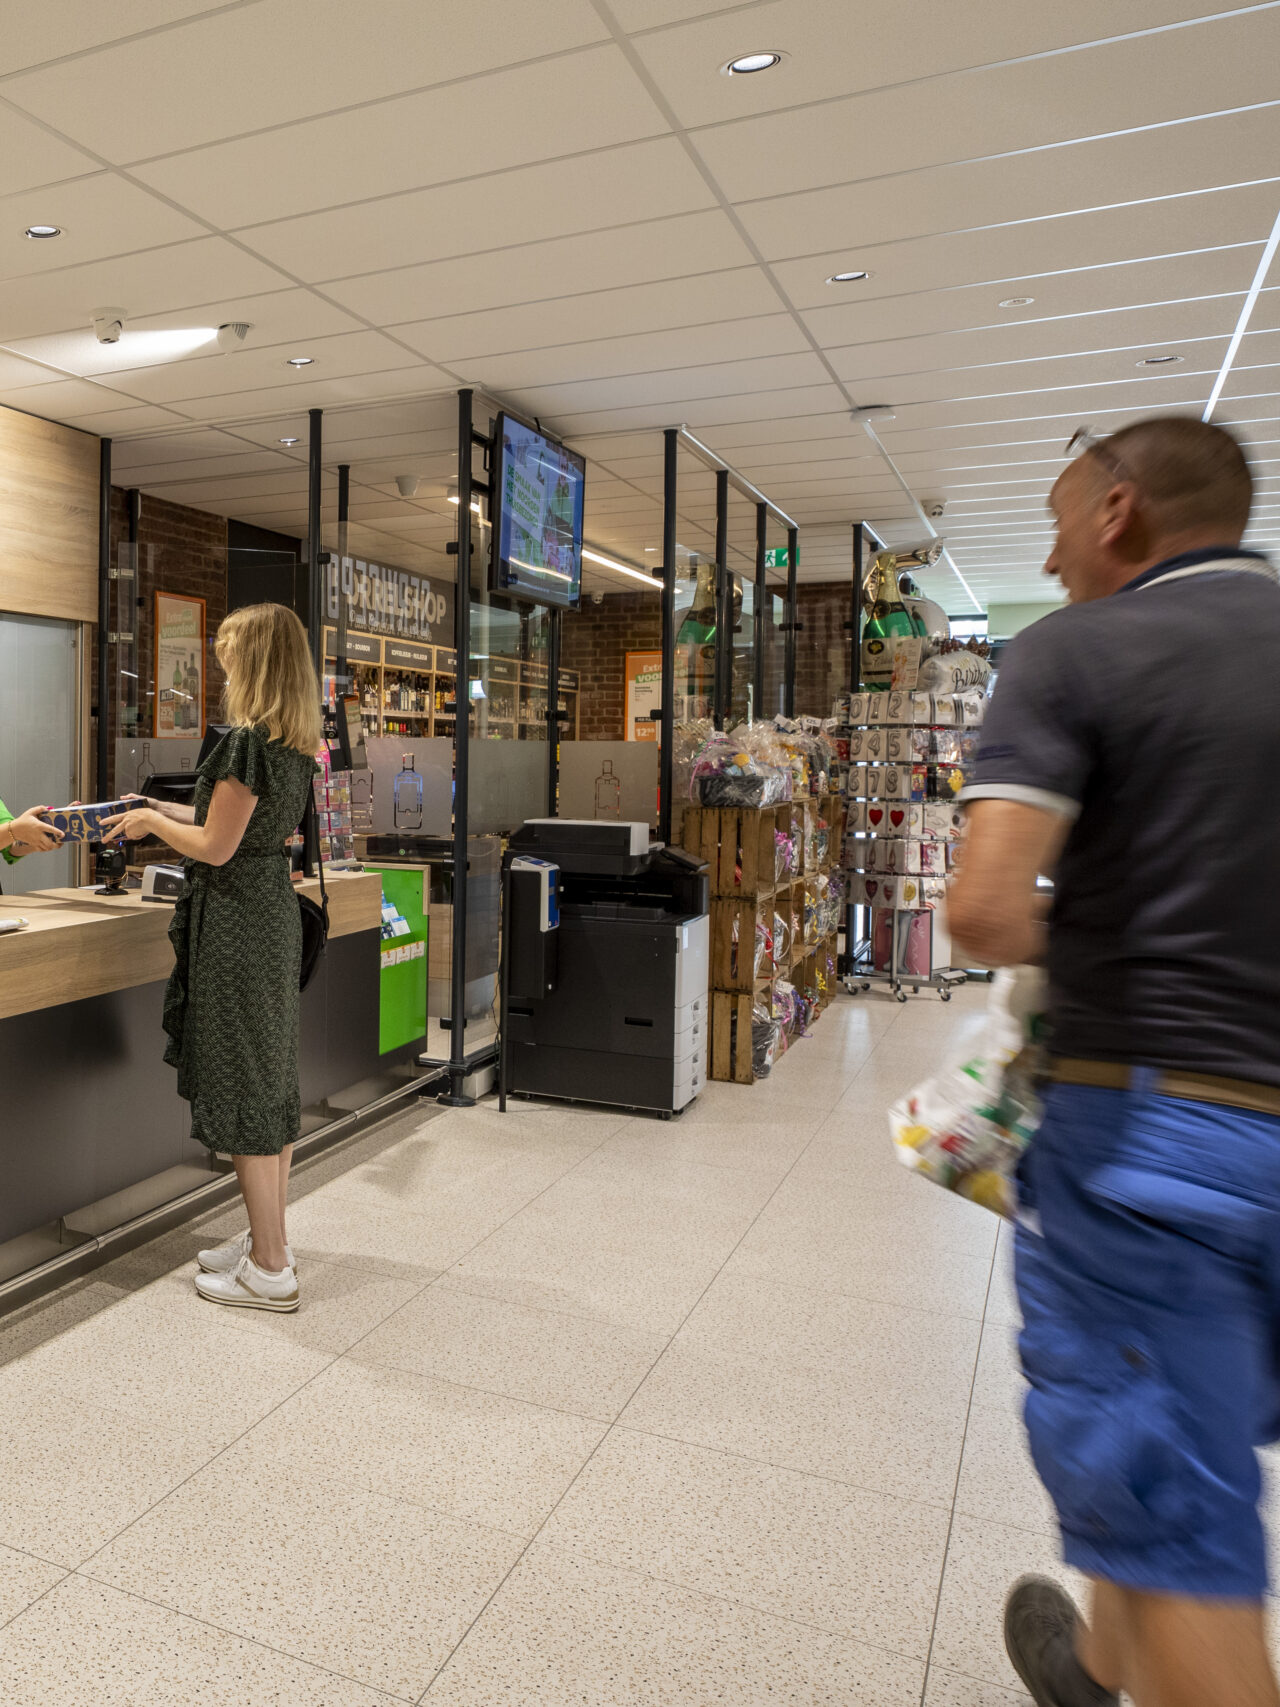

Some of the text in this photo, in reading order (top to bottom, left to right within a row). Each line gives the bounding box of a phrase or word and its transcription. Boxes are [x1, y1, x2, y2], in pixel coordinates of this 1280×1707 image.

[850, 700, 862, 719] 0
[870, 698, 881, 719] 1
[888, 695, 903, 718] 2
[850, 733, 863, 756] 3
[868, 733, 880, 756] 4
[888, 733, 900, 757] 5
[849, 770, 860, 792] 6
[869, 770, 880, 793] 7
[886, 769, 899, 793] 8
